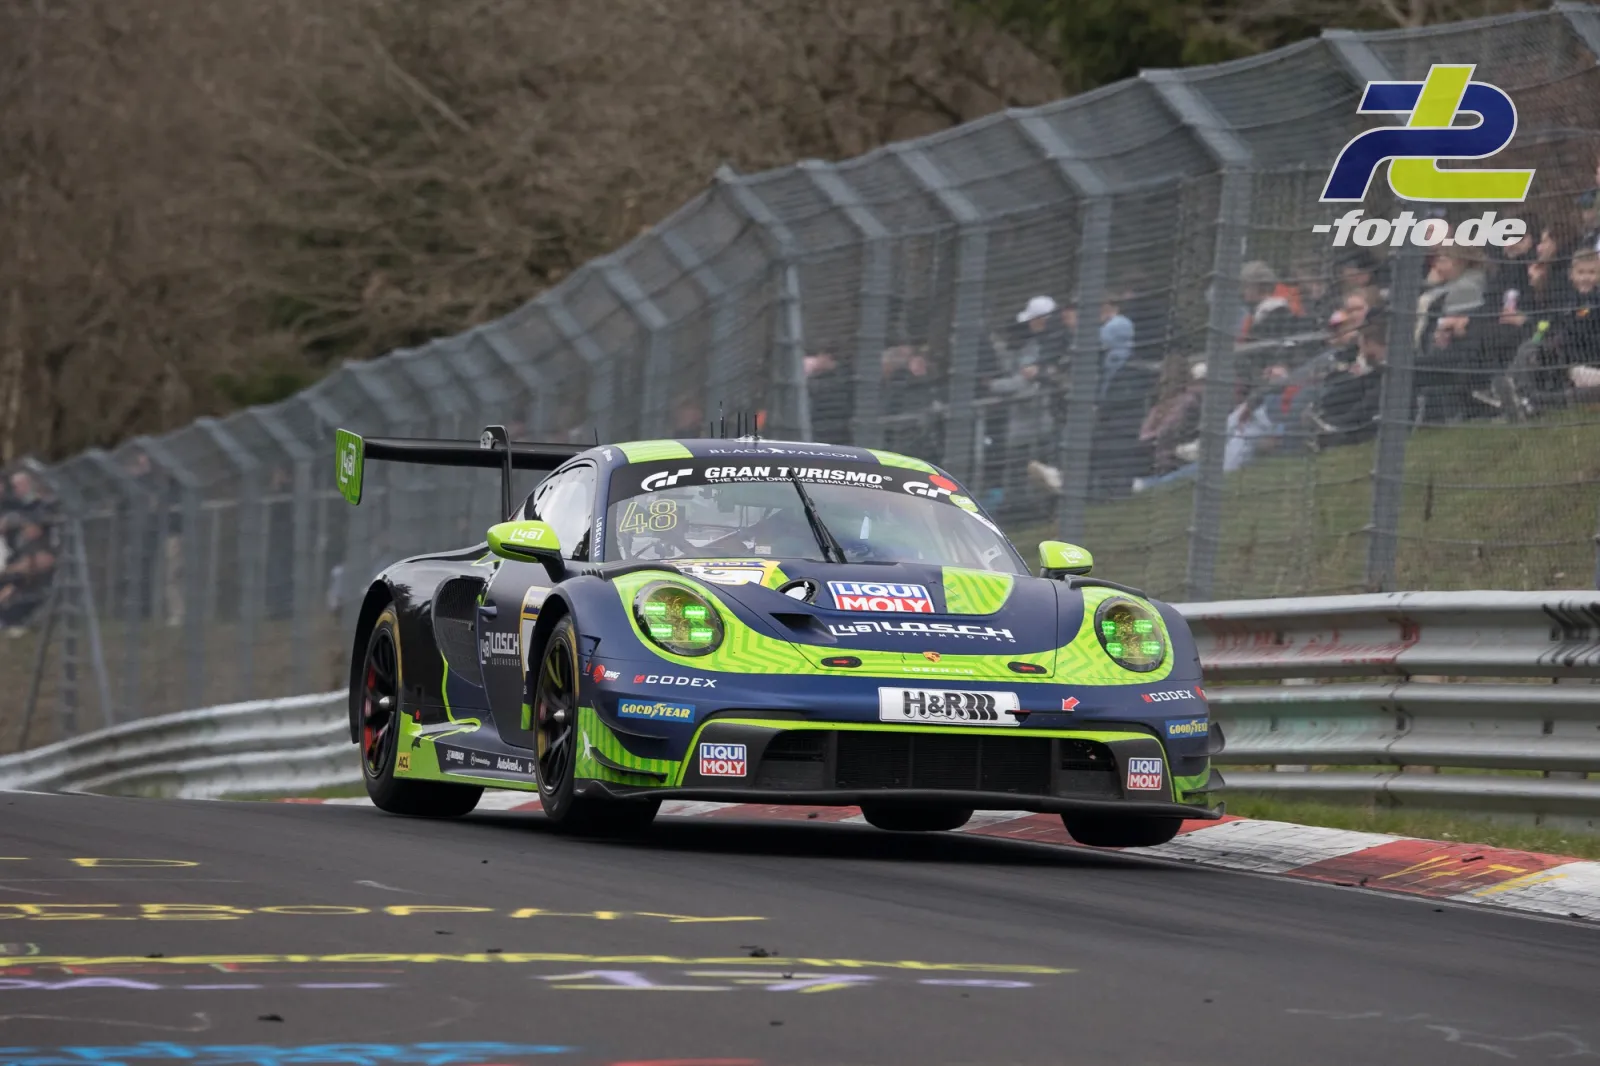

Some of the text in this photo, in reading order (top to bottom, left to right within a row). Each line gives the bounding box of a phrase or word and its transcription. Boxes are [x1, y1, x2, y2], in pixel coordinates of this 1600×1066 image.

[704, 467, 770, 478] GRAN
[619, 499, 678, 533] 48
[837, 583, 923, 598] LIQUI
[842, 597, 925, 613] MOLY
[645, 675, 718, 688] CODEX
[1150, 690, 1195, 702] CODEX
[621, 702, 691, 718] GOODYEAR
[703, 746, 743, 760] LIQUI
[703, 760, 743, 775] MOLY
[1131, 760, 1161, 774] LIQUI
[1130, 774, 1161, 788] MOLY
